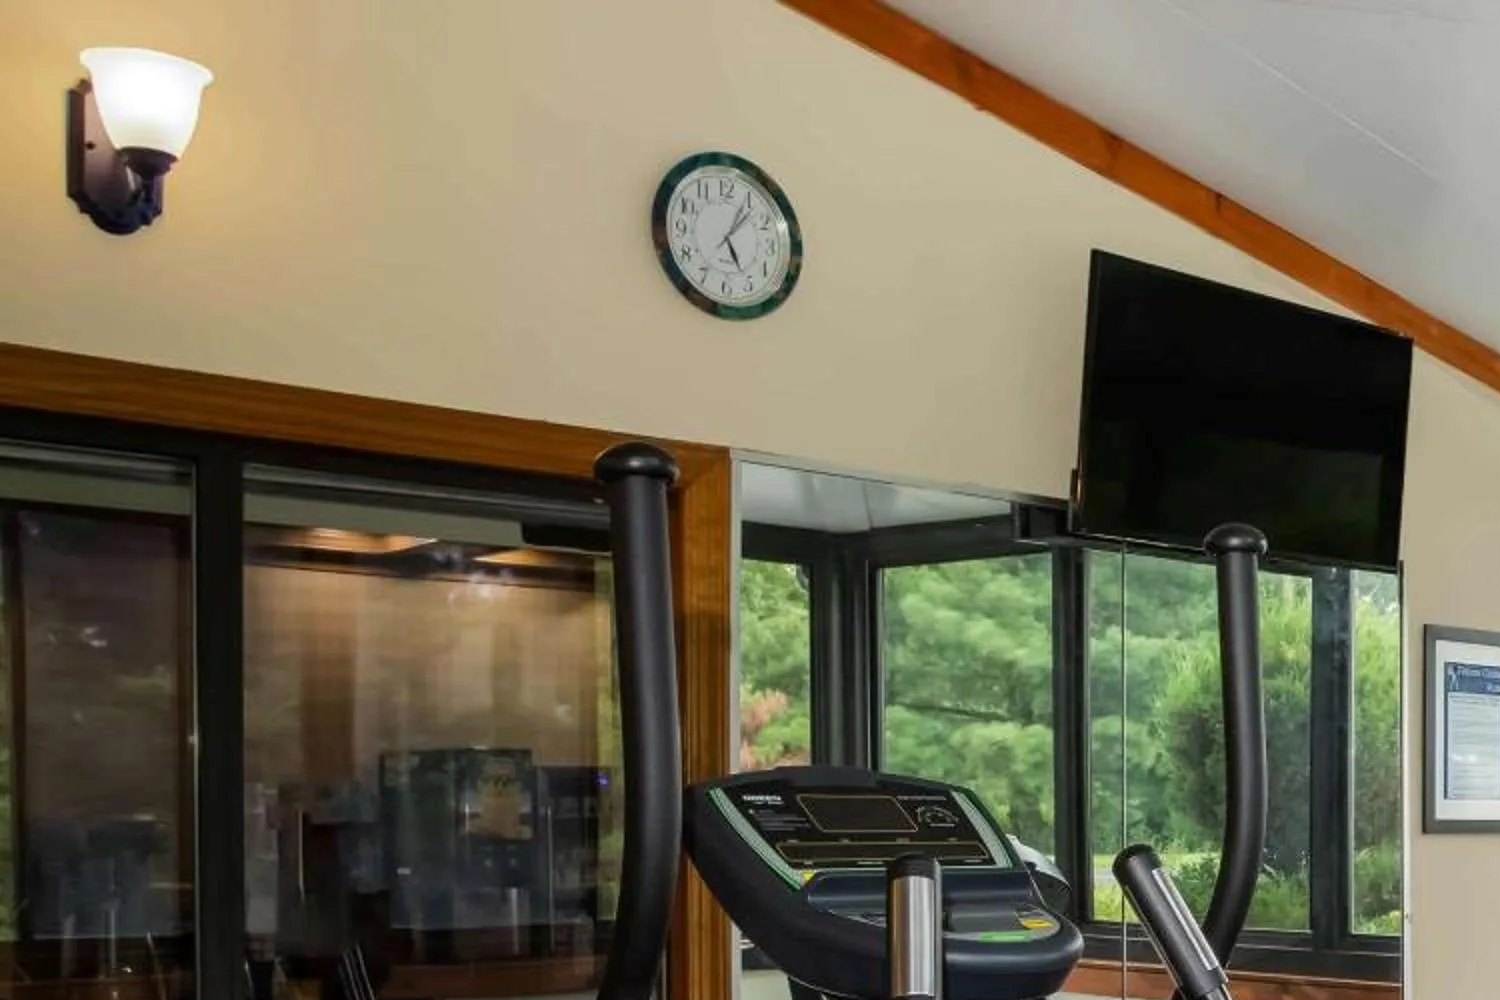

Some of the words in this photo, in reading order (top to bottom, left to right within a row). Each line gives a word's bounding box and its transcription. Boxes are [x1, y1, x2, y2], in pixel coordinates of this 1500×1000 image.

[697, 180, 709, 200] 11
[719, 179, 735, 199] 12
[699, 266, 708, 285] 7
